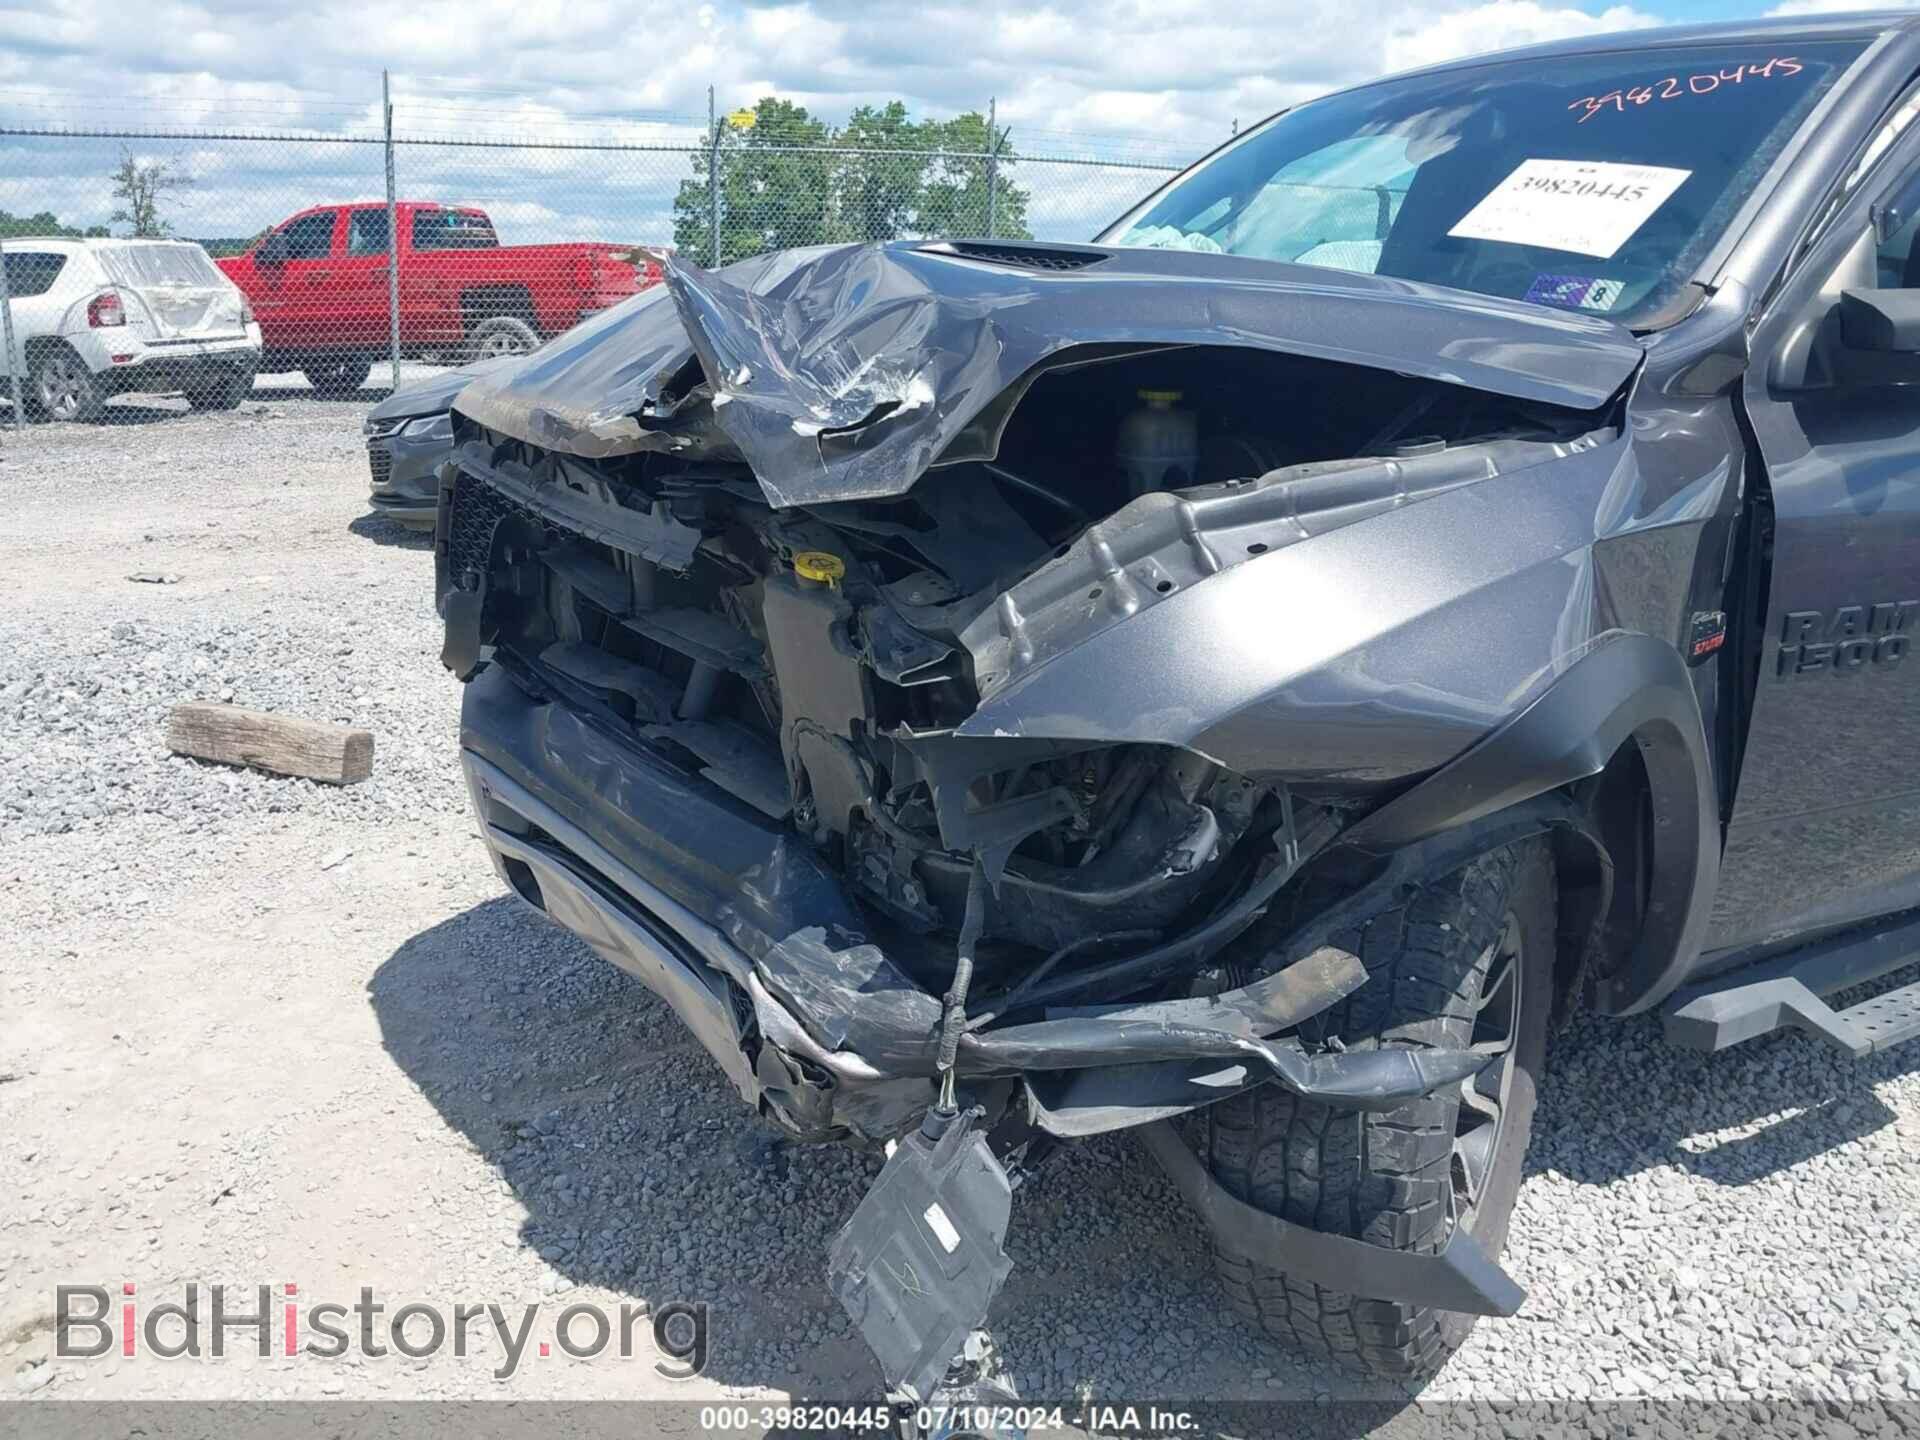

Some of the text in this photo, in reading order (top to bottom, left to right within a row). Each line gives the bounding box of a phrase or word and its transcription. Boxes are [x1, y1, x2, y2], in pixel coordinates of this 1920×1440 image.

[1567, 57, 1803, 124] 39820445
[1512, 176, 1649, 201] 39820445
[1592, 286, 1607, 303] 8
[1780, 599, 1920, 643] RAM
[1776, 634, 1911, 677] 1500
